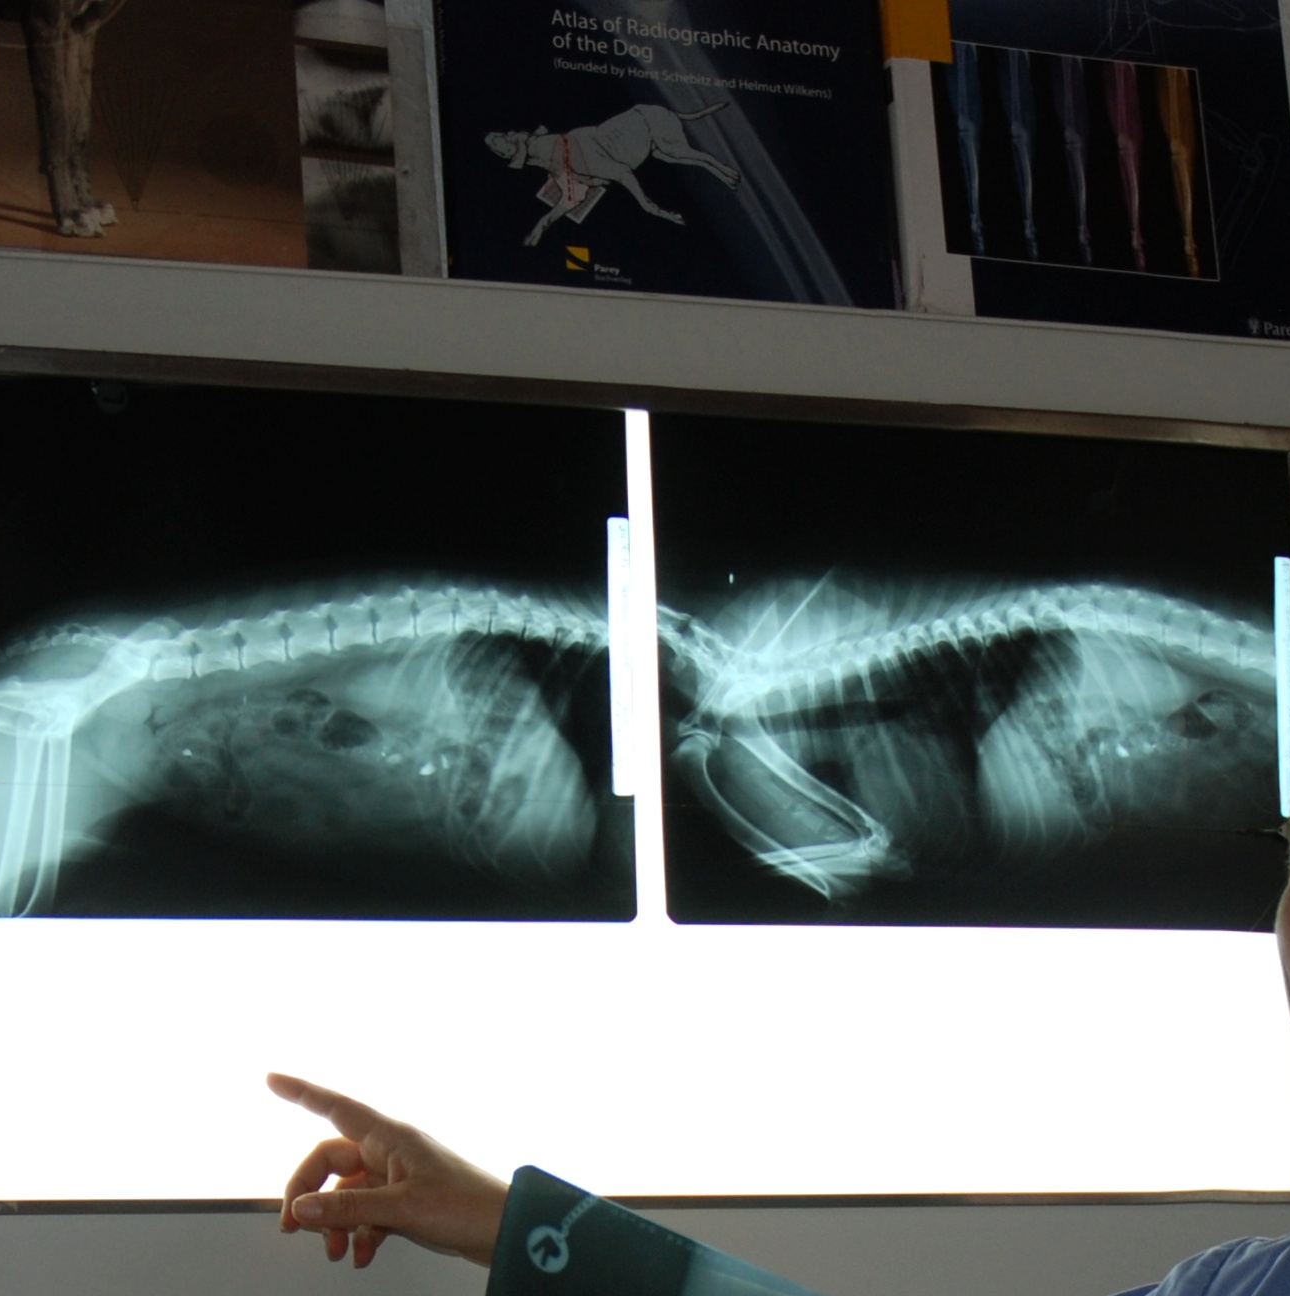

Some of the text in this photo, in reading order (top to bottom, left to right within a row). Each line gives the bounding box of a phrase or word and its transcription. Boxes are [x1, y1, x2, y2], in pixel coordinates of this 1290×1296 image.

[551, 9, 841, 62] Atlas of Radiographic Anatomy
[552, 32, 653, 63] of the Dog
[553, 57, 608, 74] (founded
[610, 63, 625, 79] by
[628, 66, 659, 81] Horst
[714, 78, 737, 90] and
[738, 79, 782, 95] Helmut
[783, 83, 833, 100] Wilkens)
[593, 263, 621, 276] Parey
